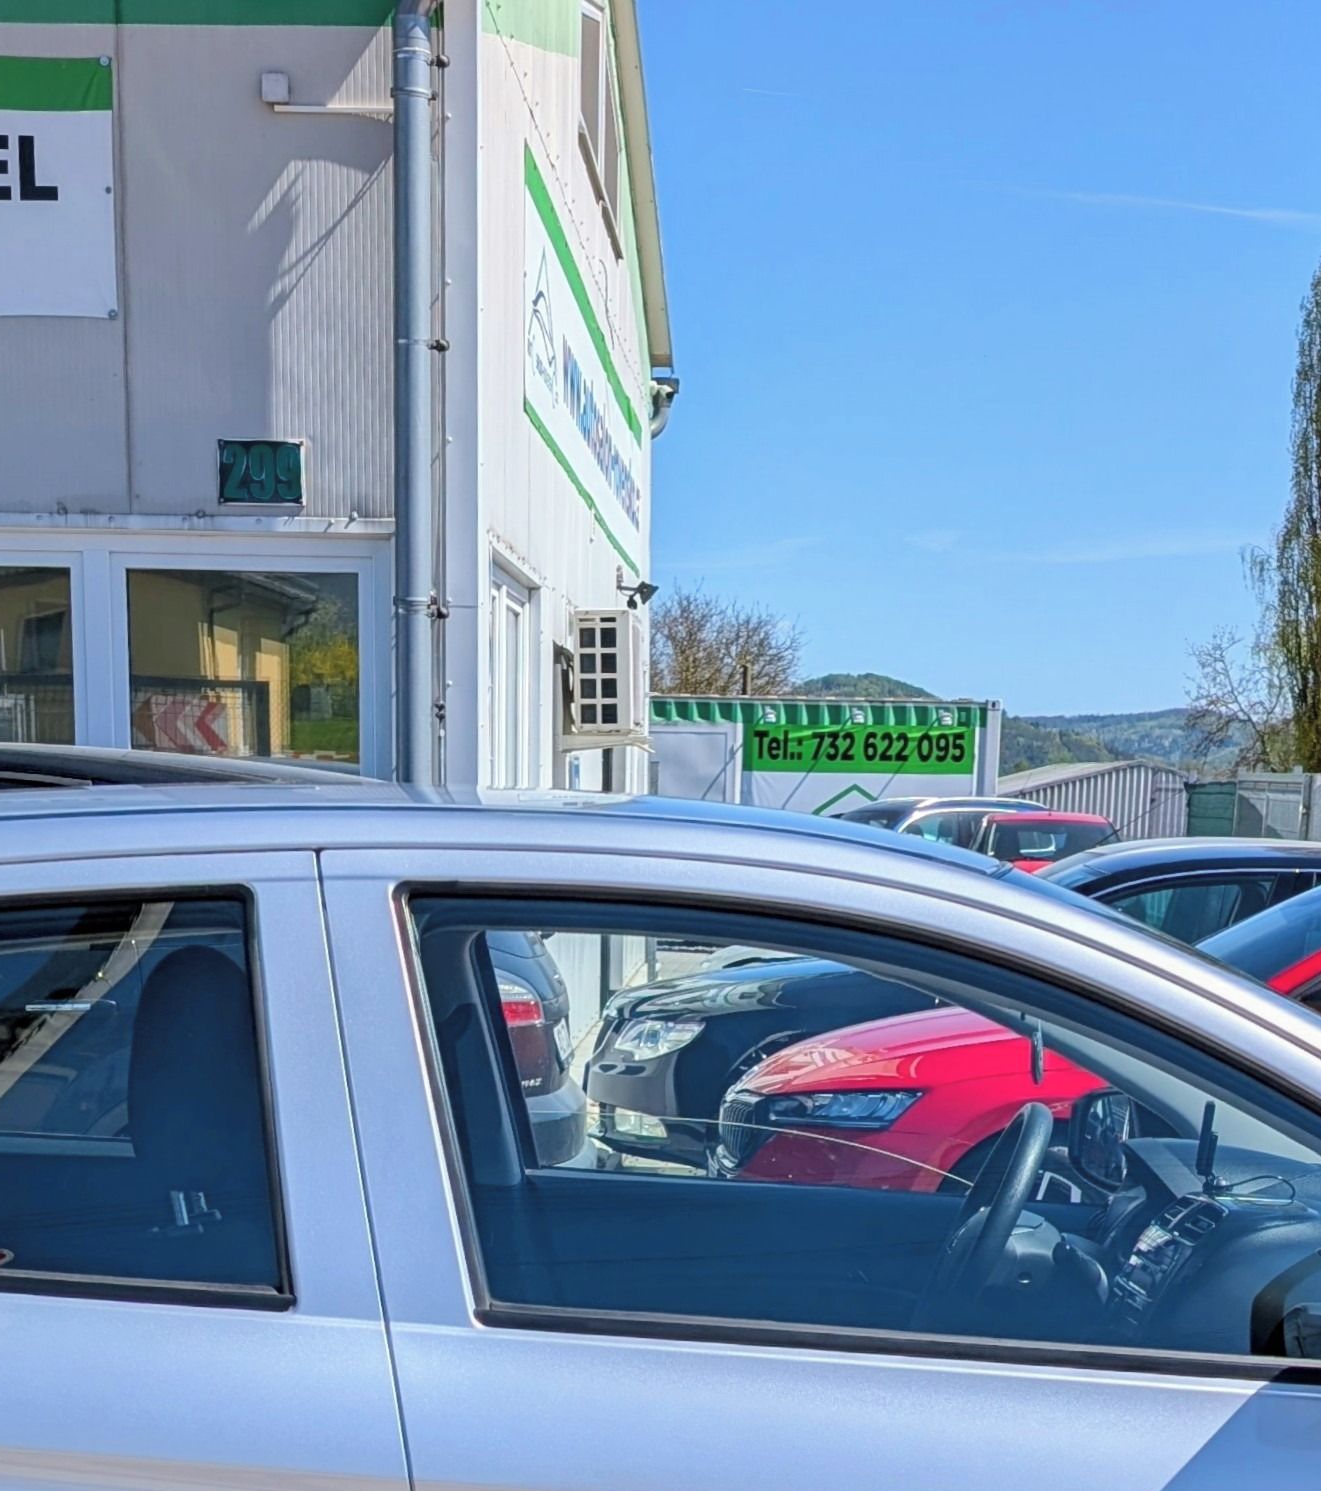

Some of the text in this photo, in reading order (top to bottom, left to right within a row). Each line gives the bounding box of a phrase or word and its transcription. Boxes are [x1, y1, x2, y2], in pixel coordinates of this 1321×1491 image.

[222, 443, 302, 500] 299
[753, 730, 966, 763] Tel.: 732 622 095
